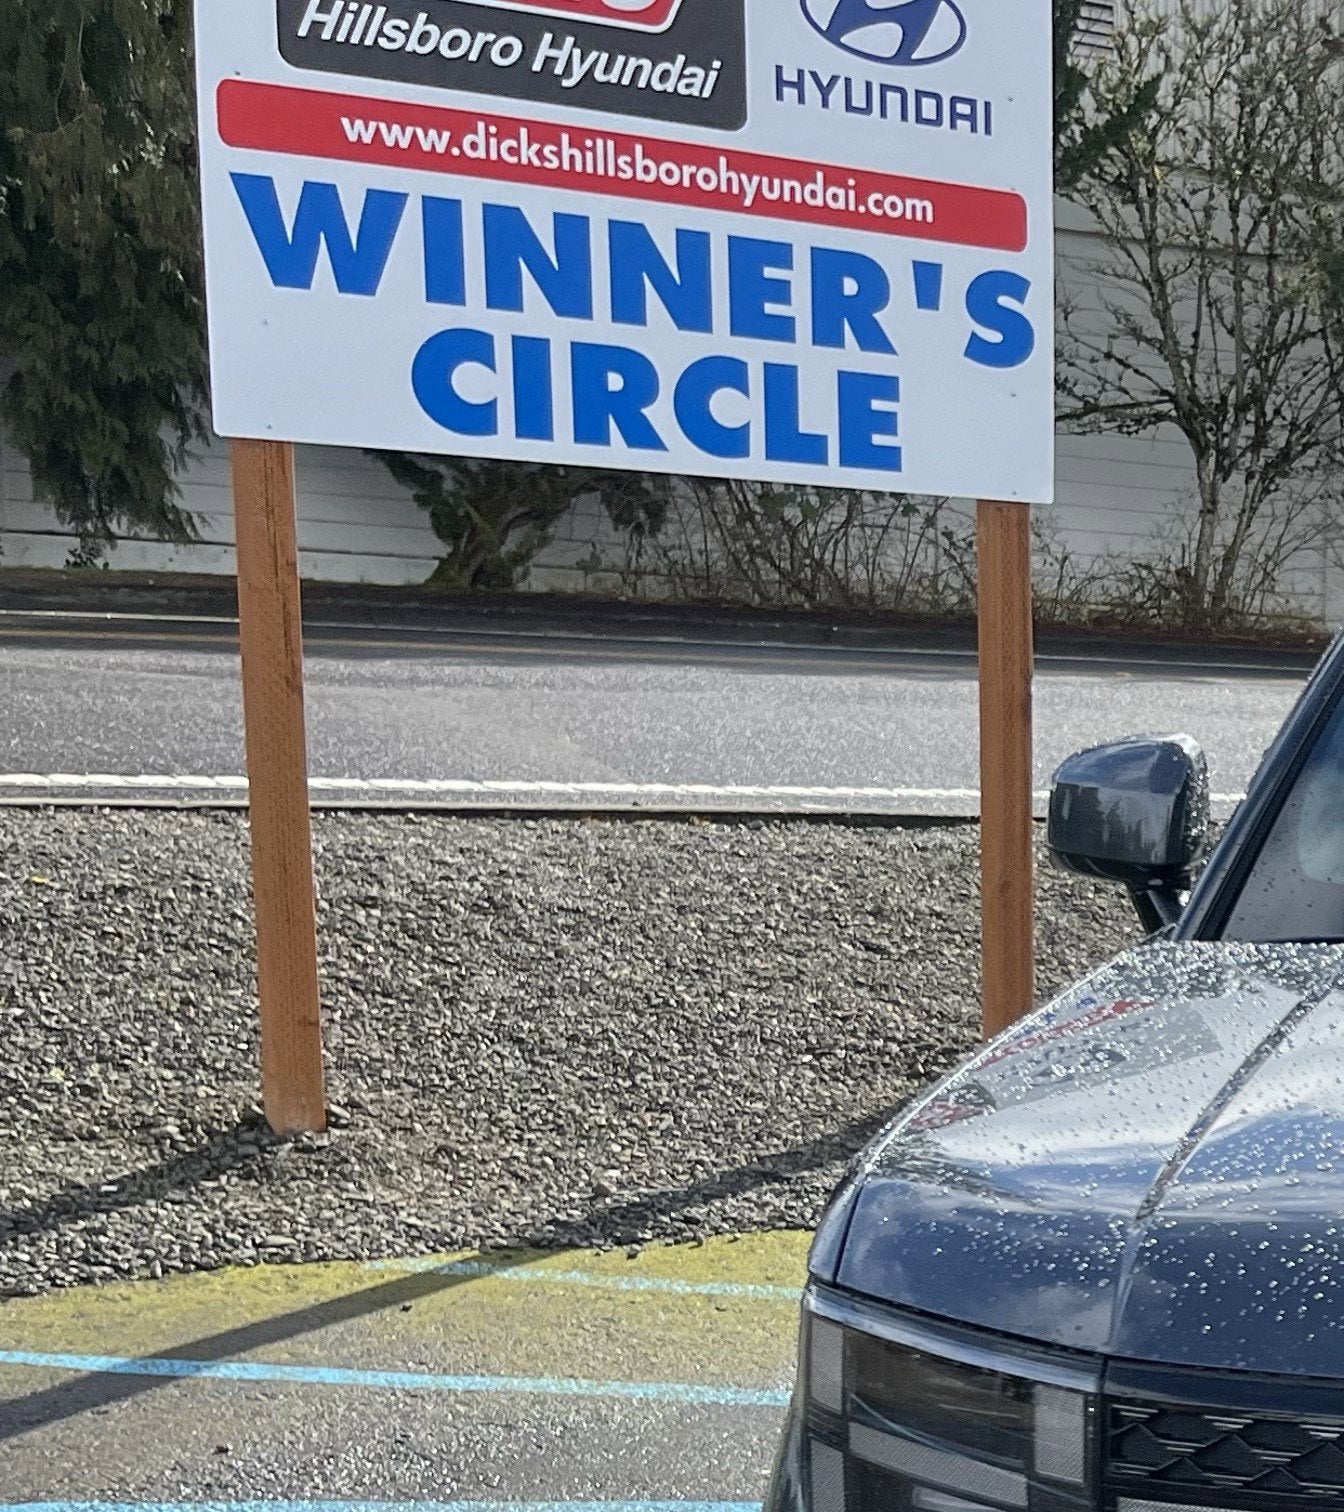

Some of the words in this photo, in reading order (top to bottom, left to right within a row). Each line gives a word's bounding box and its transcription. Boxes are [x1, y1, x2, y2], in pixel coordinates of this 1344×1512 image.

[297, 0, 523, 67] Hillsboro
[531, 32, 723, 100] Hyundai
[775, 65, 993, 137] HYUNDAI
[340, 114, 934, 226] www.dickshillsborohyundai.com
[228, 171, 1036, 369] WINNER'S
[411, 327, 904, 473] CIRCLE
